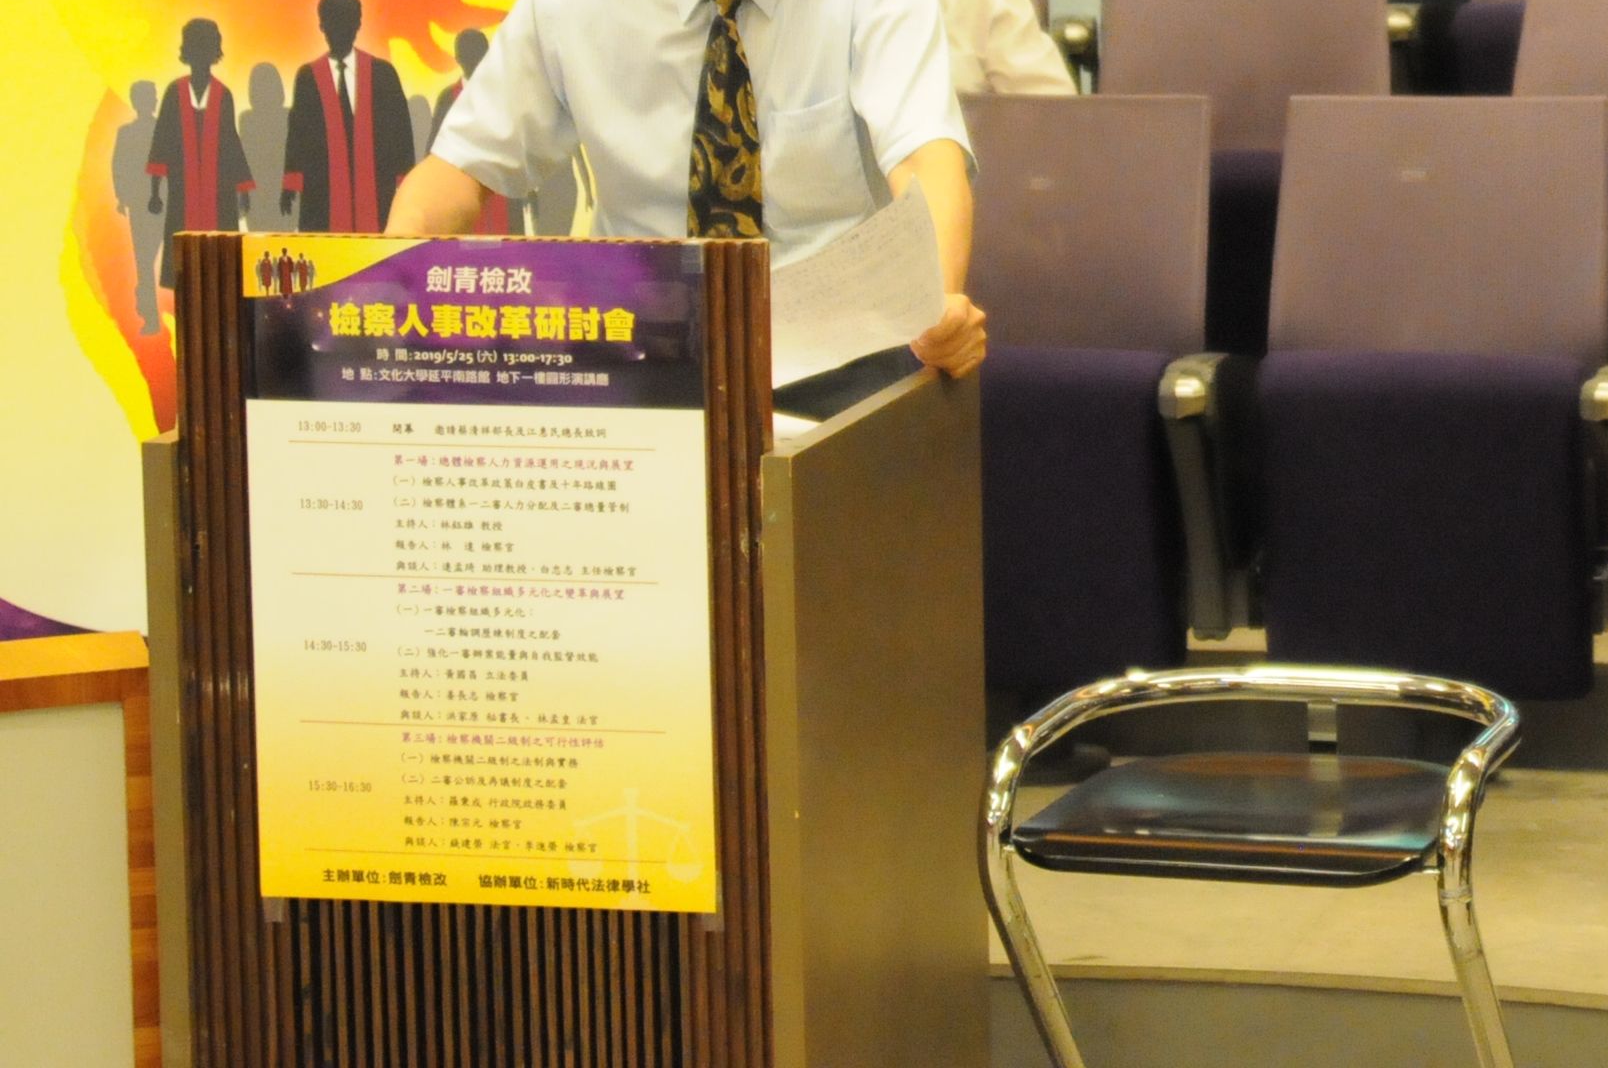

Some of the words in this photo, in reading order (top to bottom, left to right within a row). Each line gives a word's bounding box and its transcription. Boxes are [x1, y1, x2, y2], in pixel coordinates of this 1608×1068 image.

[426, 265, 533, 294] 劍青檢改
[329, 302, 636, 342] 檢察人事改革研討會
[502, 351, 574, 366] 13:00-17:30
[298, 420, 362, 433] 13:00-13:30
[300, 498, 364, 511] 13:30-14:30
[480, 520, 504, 532] 教授
[480, 541, 515, 553] 檢察官
[303, 639, 368, 653] 14:30-15:30
[484, 670, 530, 683] 立法委員
[484, 690, 519, 703] 檢察官
[576, 714, 600, 726] 法官
[308, 779, 373, 794] 15:30-16:30
[488, 817, 523, 831] 檢察官
[563, 840, 599, 854] 檢察官
